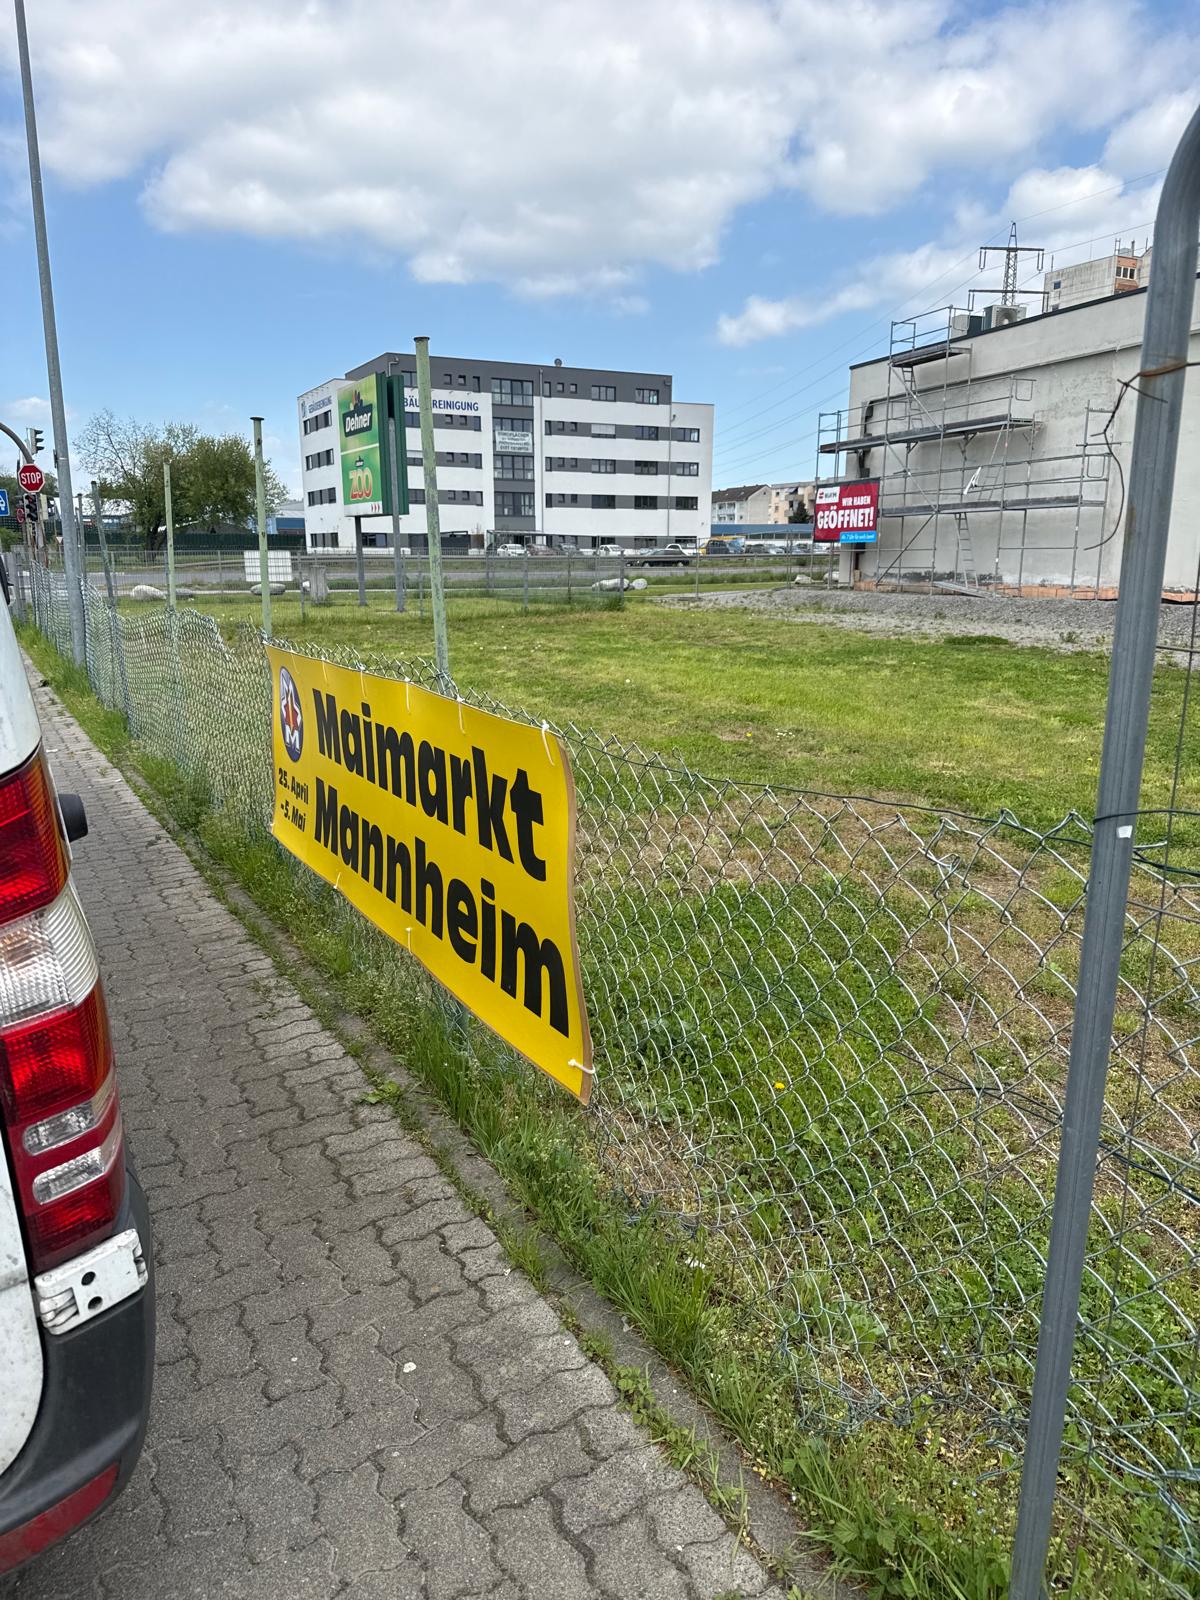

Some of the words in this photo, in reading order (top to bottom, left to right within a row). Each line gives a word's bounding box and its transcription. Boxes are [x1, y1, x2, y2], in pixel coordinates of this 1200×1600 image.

[404, 395, 479, 412] BÄUREINIGUNG
[345, 411, 371, 433] Dehner
[20, 472, 41, 485] STOP
[349, 467, 373, 500] ZOO
[842, 497, 852, 506] WIR
[853, 495, 871, 505] HABEN
[817, 505, 874, 529] GEÖFFNET!
[278, 767, 290, 791] 25.
[290, 775, 309, 805] April
[312, 687, 546, 882] Maimarkt
[291, 805, 306, 833] Mai
[313, 776, 569, 1038] Mannheim
